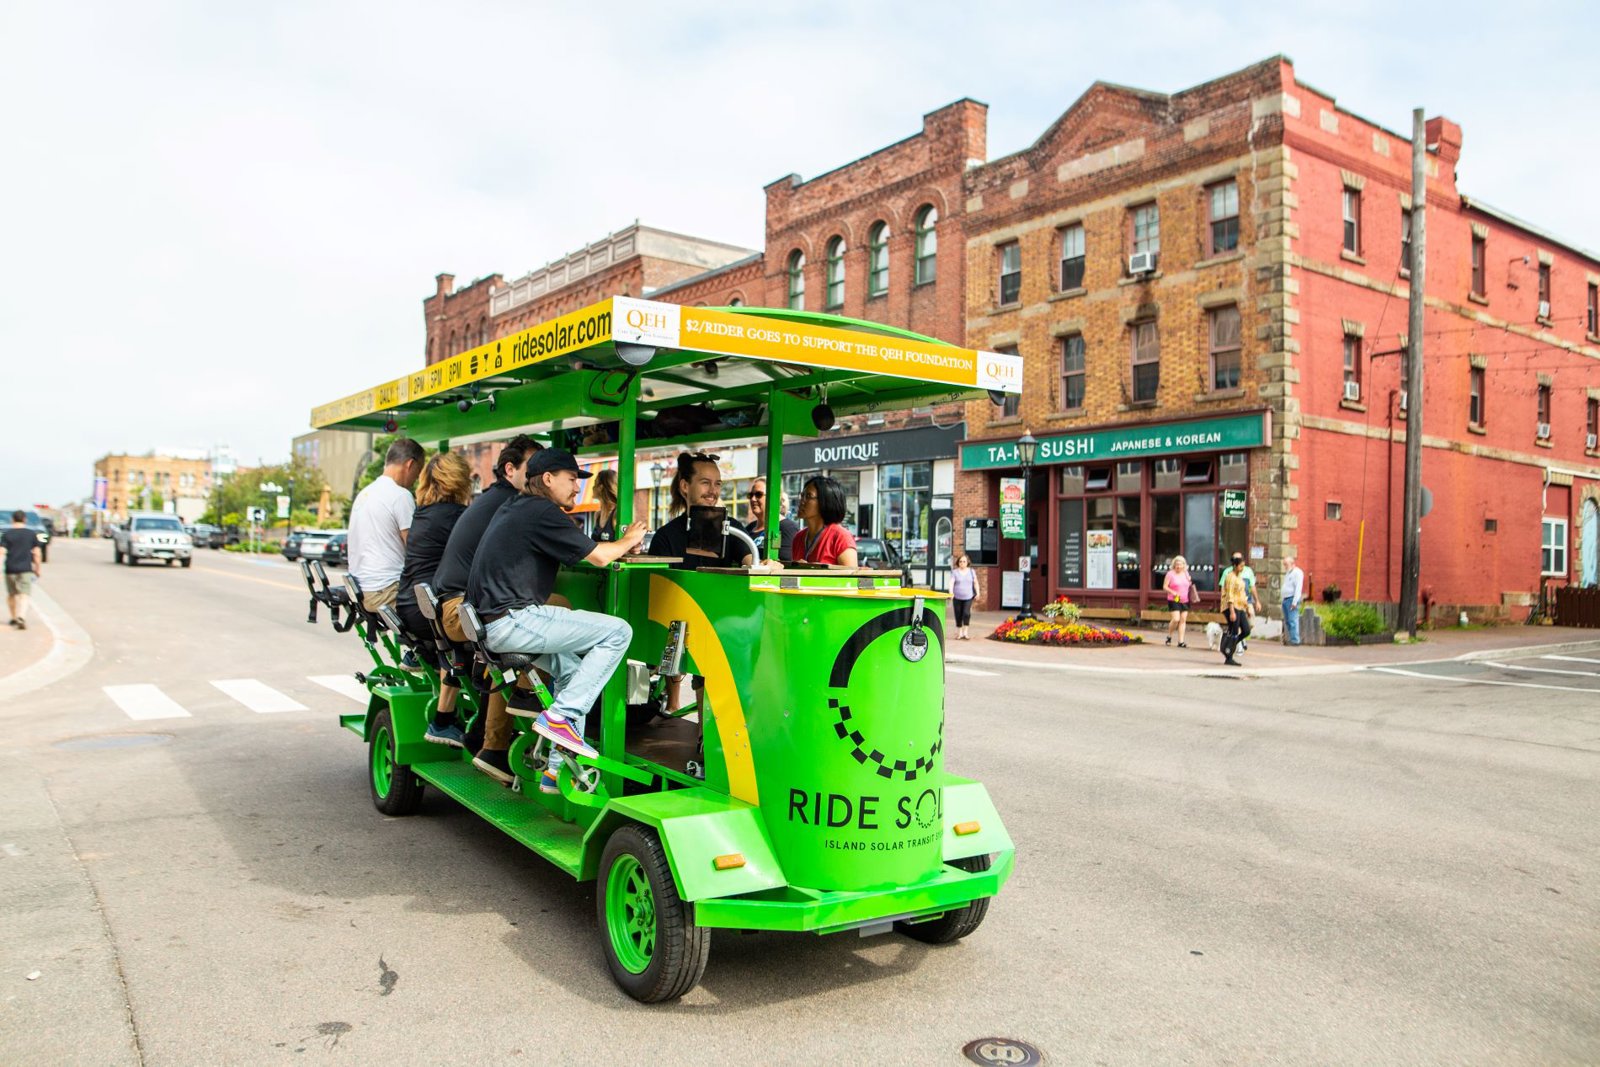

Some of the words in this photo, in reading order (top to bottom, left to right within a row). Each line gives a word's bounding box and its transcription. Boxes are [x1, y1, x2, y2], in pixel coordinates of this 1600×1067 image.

[627, 309, 667, 332] QEH
[512, 310, 611, 363] ridesolar.com
[686, 319, 744, 338] $2/RIDER
[747, 329, 780, 343] GOES
[782, 331, 801, 346] TO
[802, 336, 853, 353] SUPPORT
[856, 342, 878, 356] THE
[879, 344, 903, 361] QEH
[905, 350, 972, 371] FOUNDATION
[449, 361, 462, 383] 8PM
[1041, 438, 1094, 458] SUSHI
[1110, 437, 1162, 453] JAPANESE
[1165, 436, 1172, 447] &
[1176, 432, 1221, 446] KOREAN
[788, 788, 880, 830] RIDE
[825, 839, 866, 851] ISLAND
[871, 840, 904, 851] SOLAR
[907, 833, 935, 849] TRANSIT
